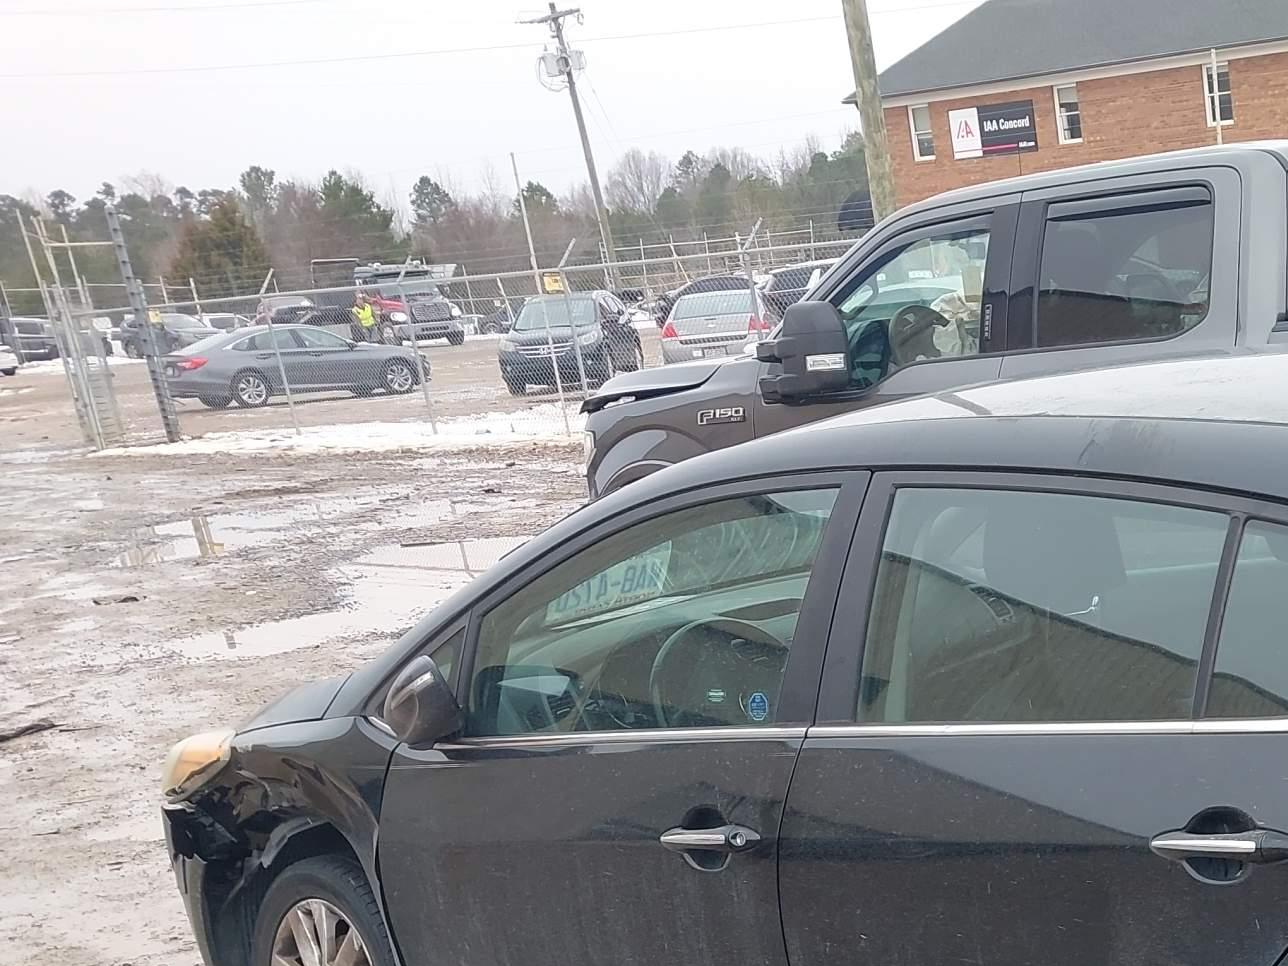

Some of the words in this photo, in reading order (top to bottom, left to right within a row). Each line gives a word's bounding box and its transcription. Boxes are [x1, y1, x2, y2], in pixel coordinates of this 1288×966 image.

[983, 119, 999, 132] IAA
[999, 115, 1030, 130] Concord
[697, 406, 745, 425] F150
